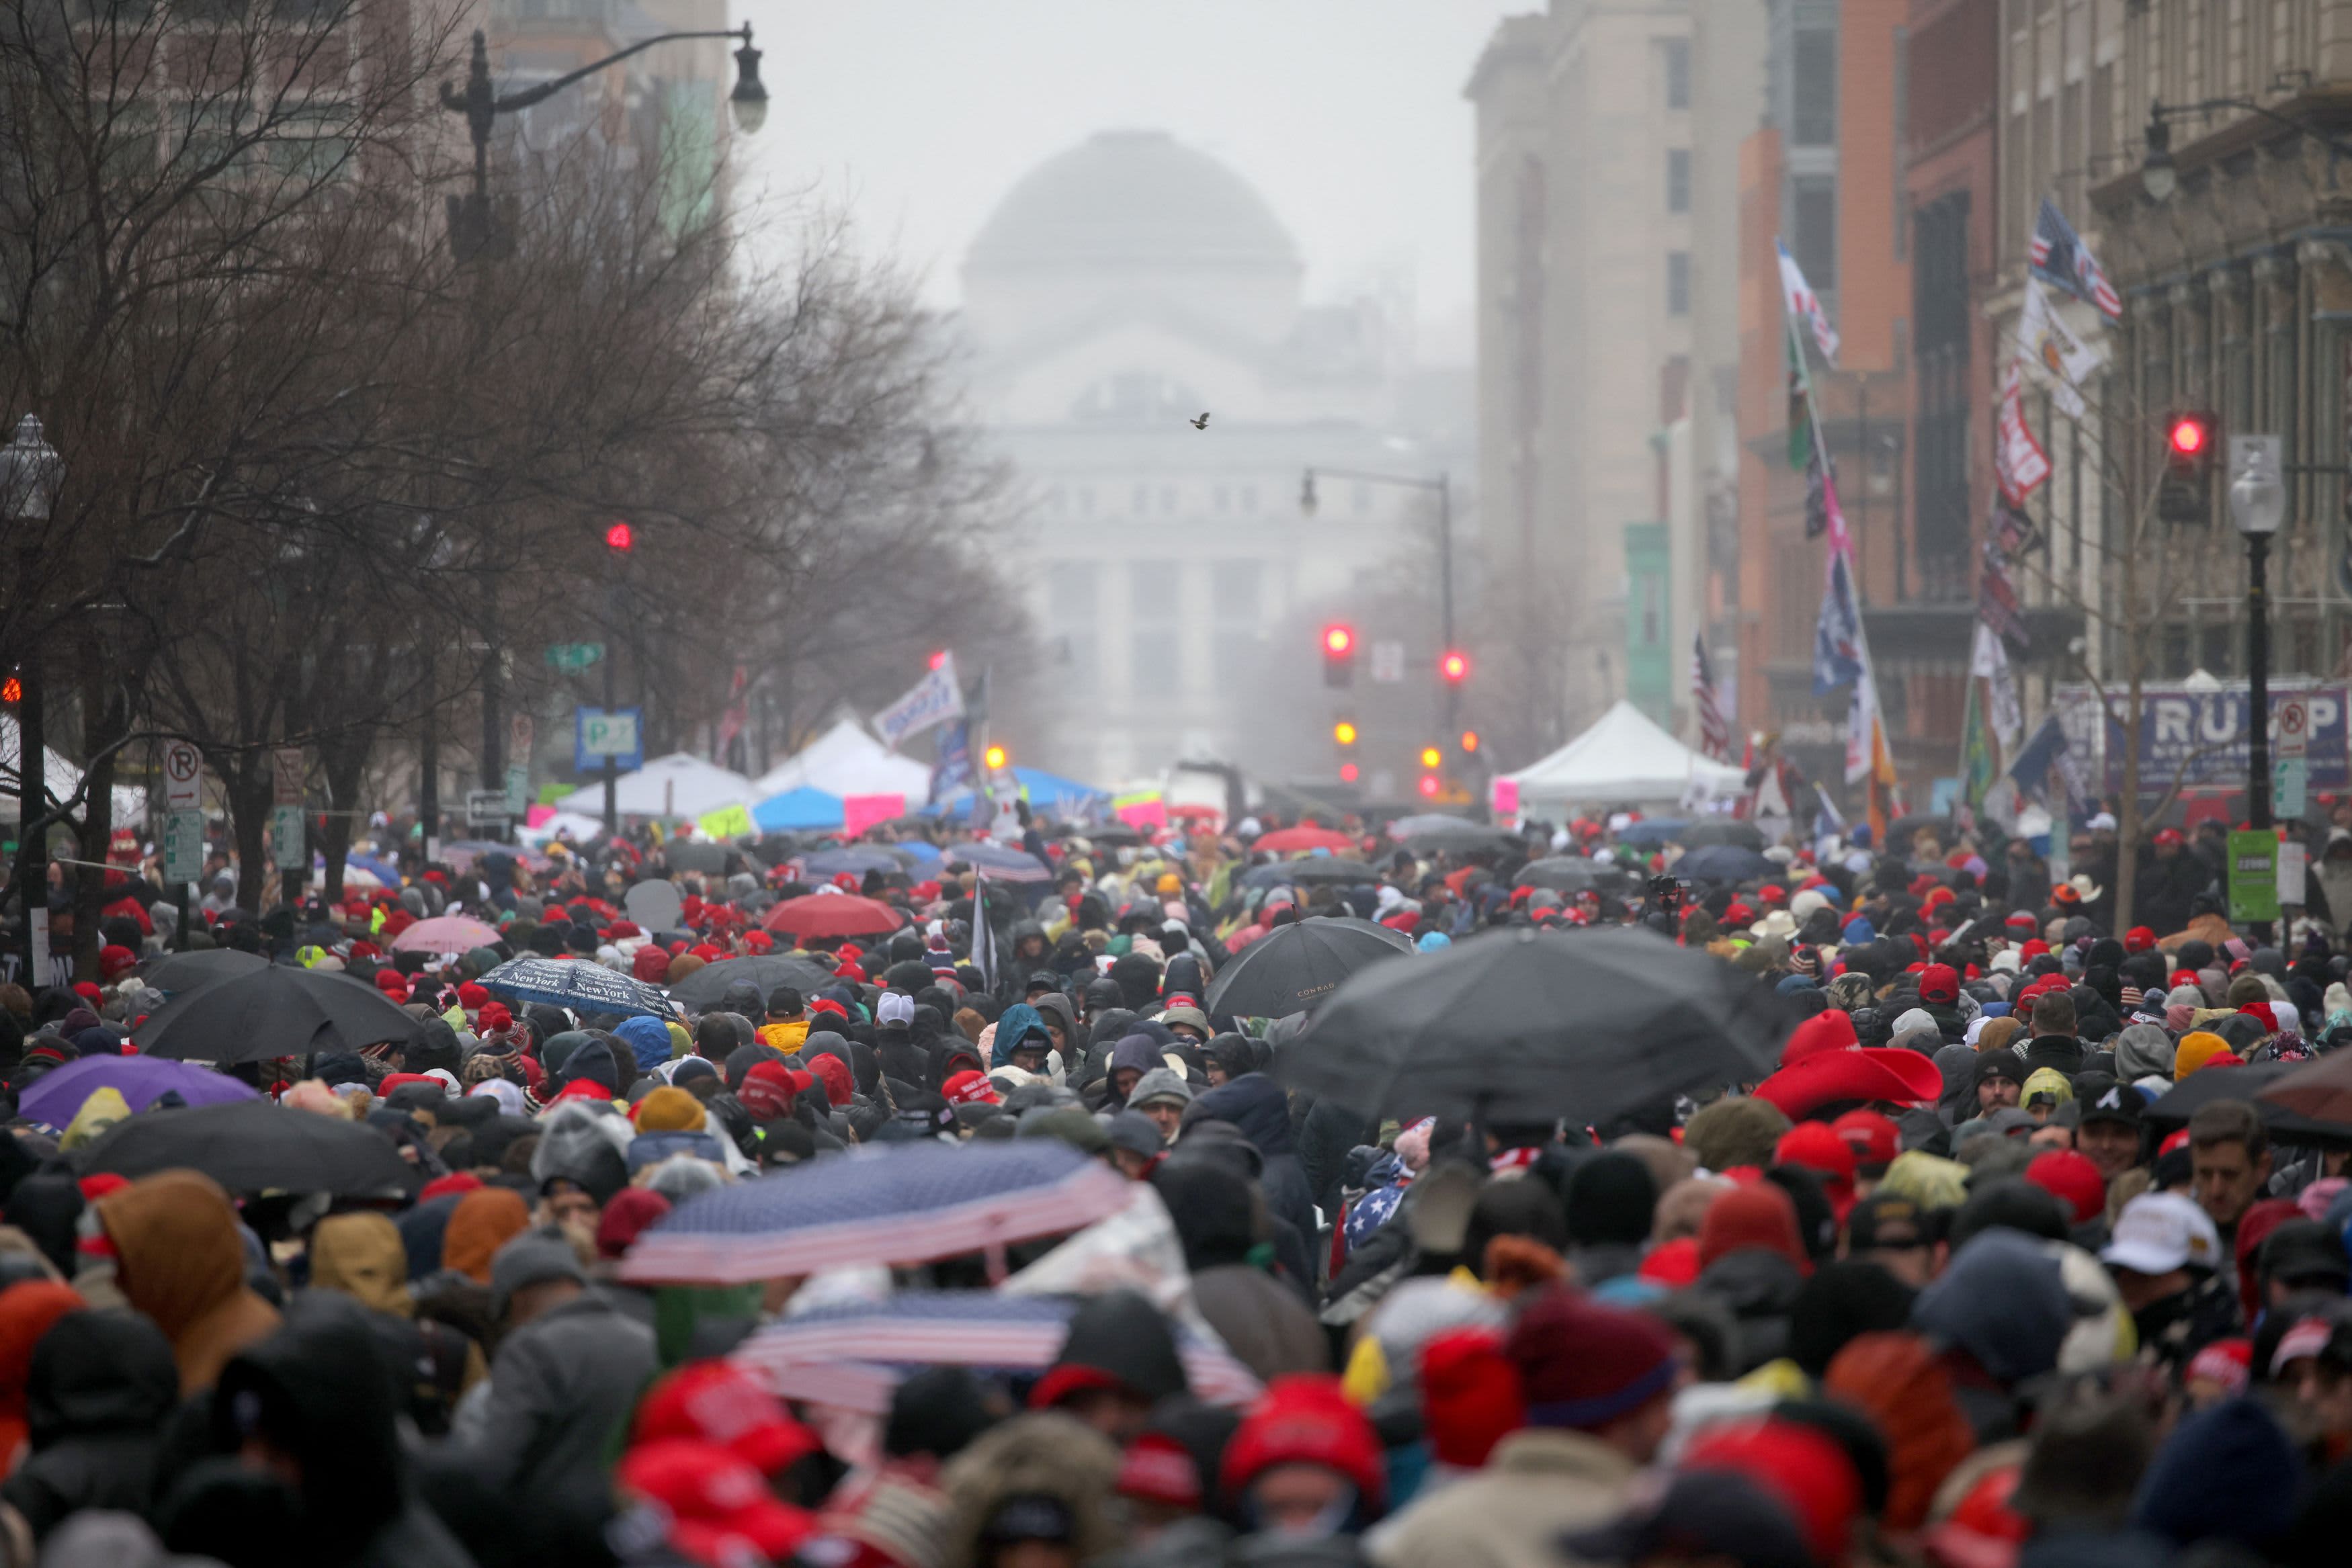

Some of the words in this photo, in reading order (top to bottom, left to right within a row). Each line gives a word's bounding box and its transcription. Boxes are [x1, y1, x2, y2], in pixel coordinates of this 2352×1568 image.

[2112, 697, 2338, 742] RUP
[513, 966, 532, 974] SoHo
[521, 961, 568, 973] Manhattan
[497, 977, 515, 986] Times
[573, 975, 593, 984] SoHo
[575, 969, 626, 984] Manhattan
[567, 989, 586, 998] Times
[587, 992, 610, 1002] square
[1297, 983, 1335, 997] CONRAD
